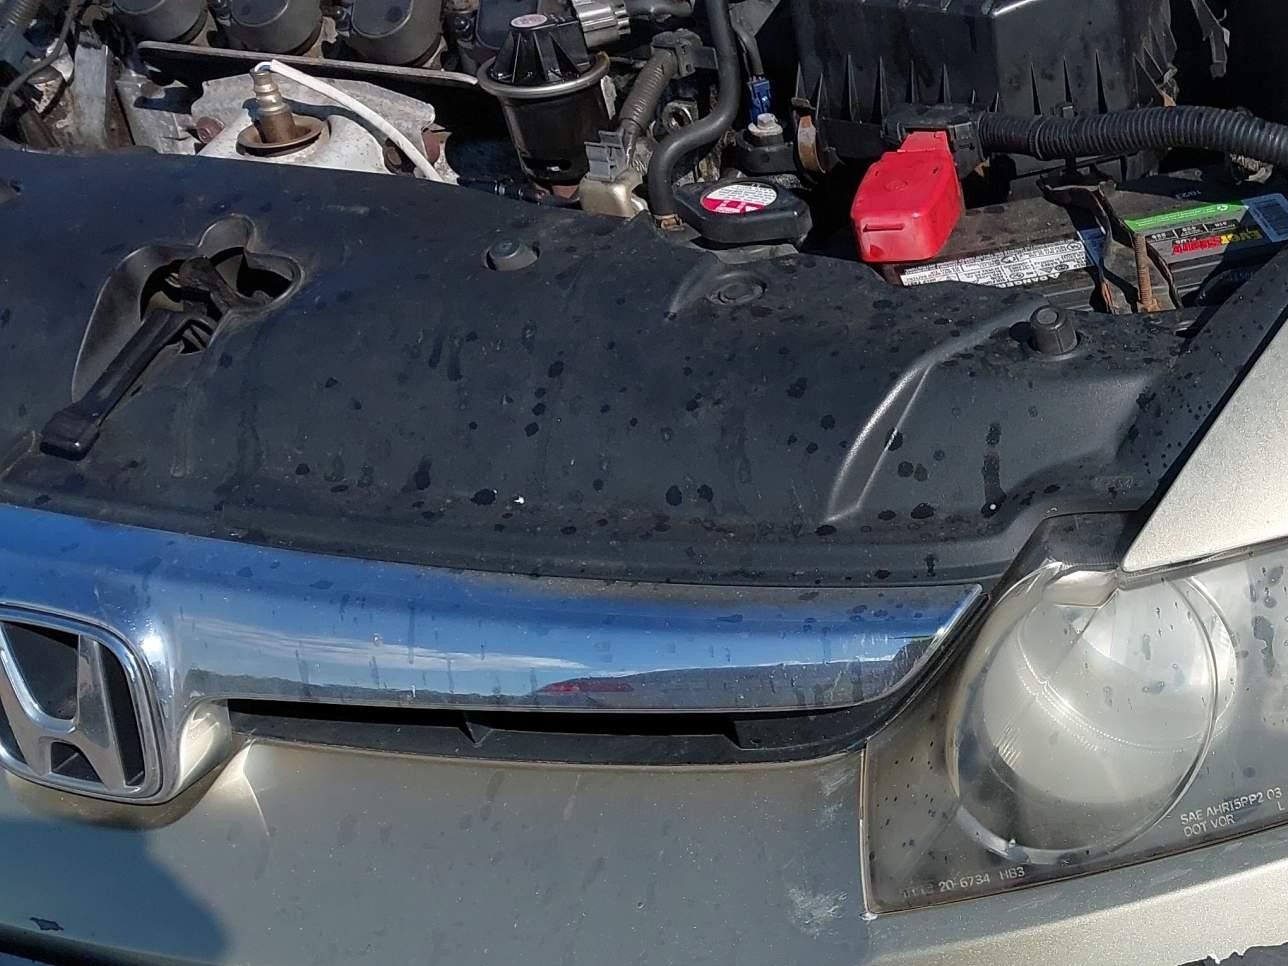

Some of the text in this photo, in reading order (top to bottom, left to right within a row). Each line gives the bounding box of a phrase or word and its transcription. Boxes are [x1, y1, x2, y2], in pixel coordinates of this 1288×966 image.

[1180, 809, 1203, 825] SAE
[1266, 787, 1282, 800] 03
[1183, 814, 1235, 837] DOT VOR
[999, 866, 1025, 881] HB3
